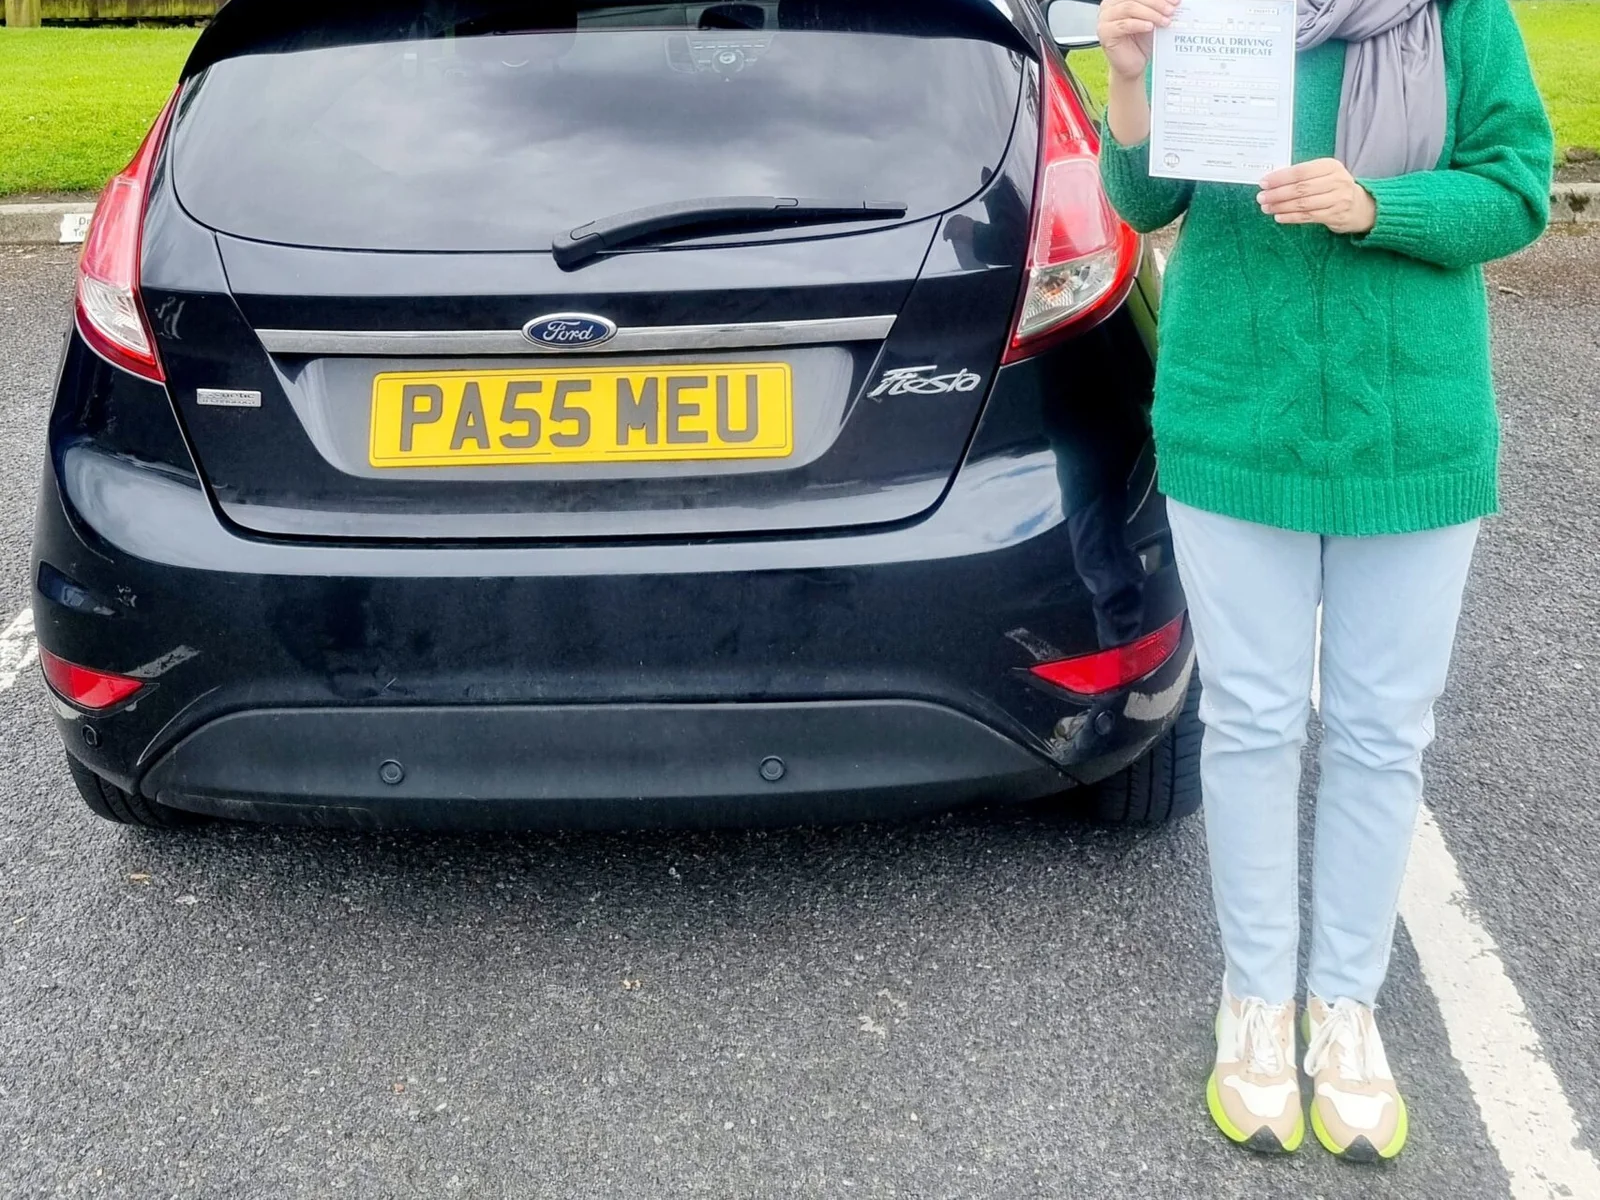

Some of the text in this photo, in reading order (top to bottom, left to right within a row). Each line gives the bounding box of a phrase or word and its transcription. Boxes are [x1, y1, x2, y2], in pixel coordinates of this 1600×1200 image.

[1174, 35, 1273, 47] PRACTICAL DRIVING
[1175, 44, 1273, 56] TEST PASS CERTIFICATE
[543, 321, 594, 341] Ford
[867, 365, 981, 400] Fiesta
[615, 376, 759, 447] MEU
